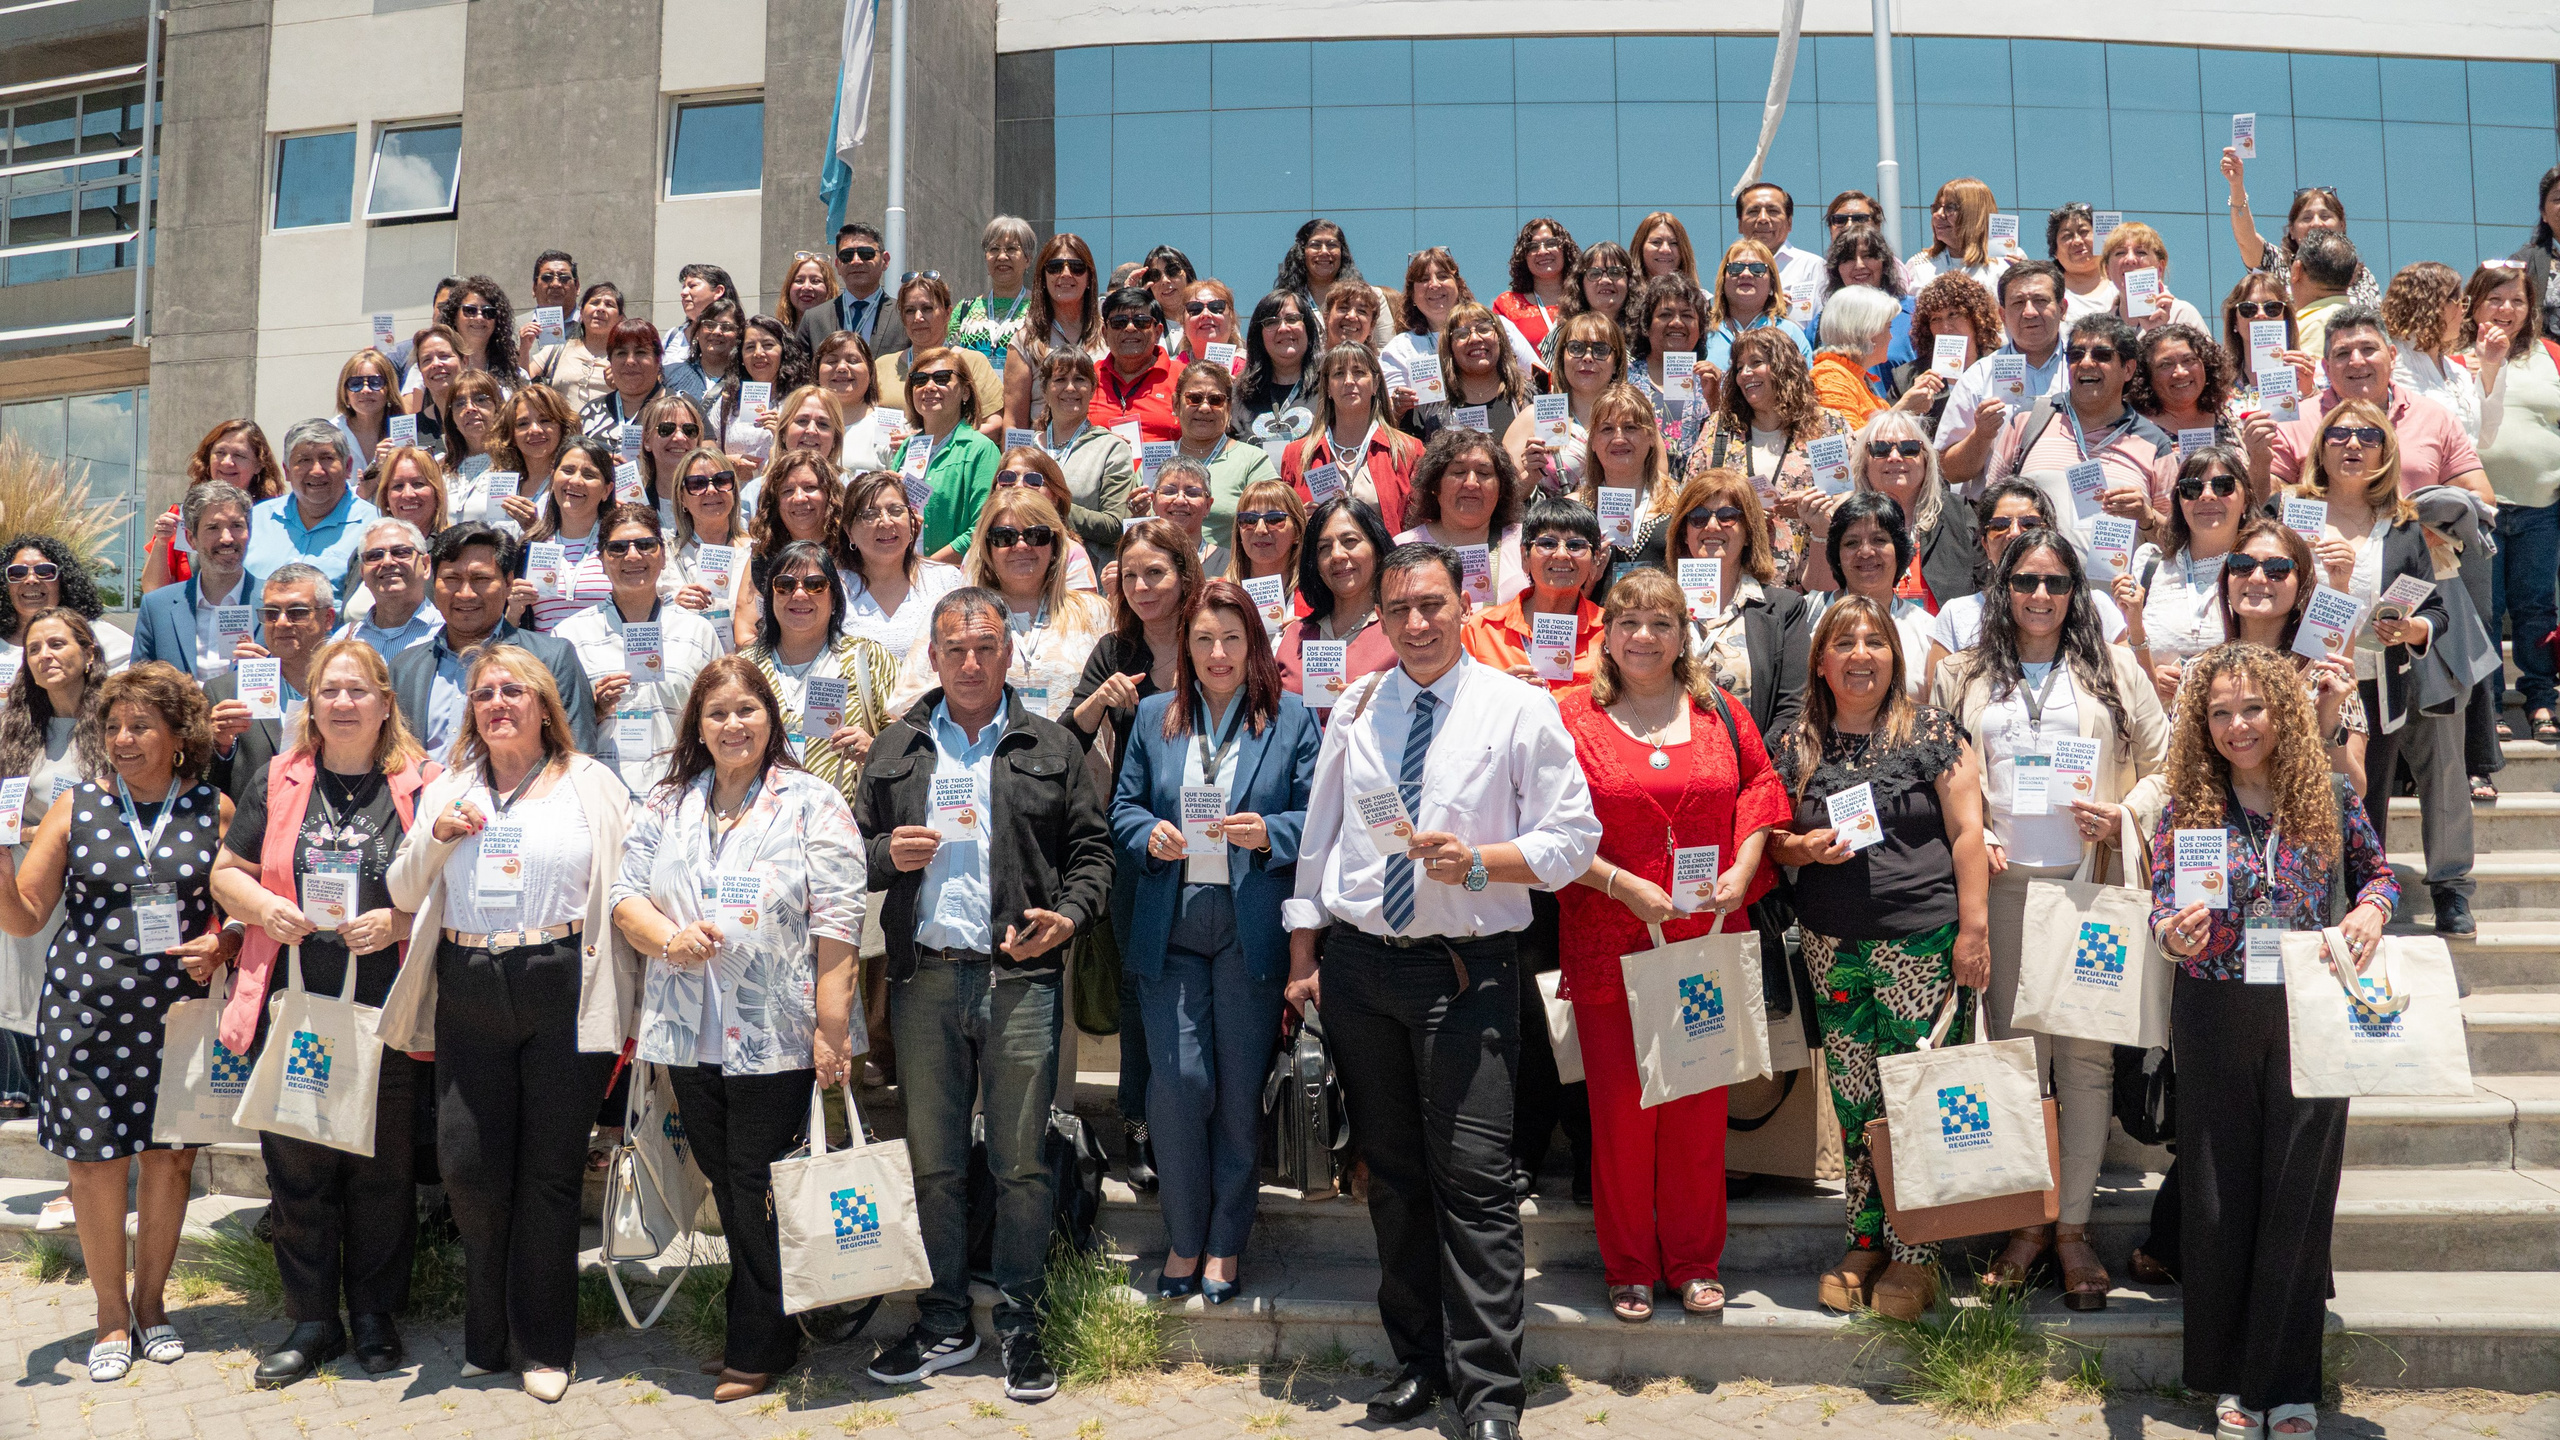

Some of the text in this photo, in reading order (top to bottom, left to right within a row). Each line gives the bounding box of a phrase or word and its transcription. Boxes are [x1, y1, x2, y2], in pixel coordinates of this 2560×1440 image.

[2108, 527, 2131, 535] CHICOS
[2110, 522, 2132, 530] TODOS
[2095, 530, 2129, 539] APRENDAN
[2093, 540, 2122, 549] ESCRIBIR
[2315, 596, 2355, 615] LOS CHICOS
[2318, 591, 2358, 610] QUE TODOS
[2313, 602, 2351, 620] APRENDAN
[2317, 609, 2335, 620] LEER
[2309, 612, 2340, 629] ESCRIBIR
[1537, 628, 1571, 636] APRENDAN
[809, 690, 842, 699] APRENDAN
[808, 700, 835, 708] ESCRIBIR
[1357, 791, 1396, 805] QUE TODOS
[1359, 796, 1398, 810] LOS CHICOS
[1362, 802, 1399, 815] APRENDAN
[1370, 810, 1388, 819] LEER
[1367, 814, 1397, 825] ESCRIBIR
[1678, 862, 1713, 870] APRENDAN
[2074, 968, 2123, 981] ENCUENTRO
[2076, 975, 2119, 987] REGIONAL
[1685, 1015, 1726, 1031] ENCUENTRO
[1689, 1023, 1724, 1037] REGIONAL
[286, 1075, 329, 1088] ENCUENTRO
[288, 1082, 325, 1094] REGIONAL
[1943, 1130, 1992, 1143] ENCUENTRO
[1948, 1138, 1990, 1149] REGIONAL
[836, 1231, 881, 1244] ENCUENTRO
[840, 1239, 879, 1250] REGIONAL
